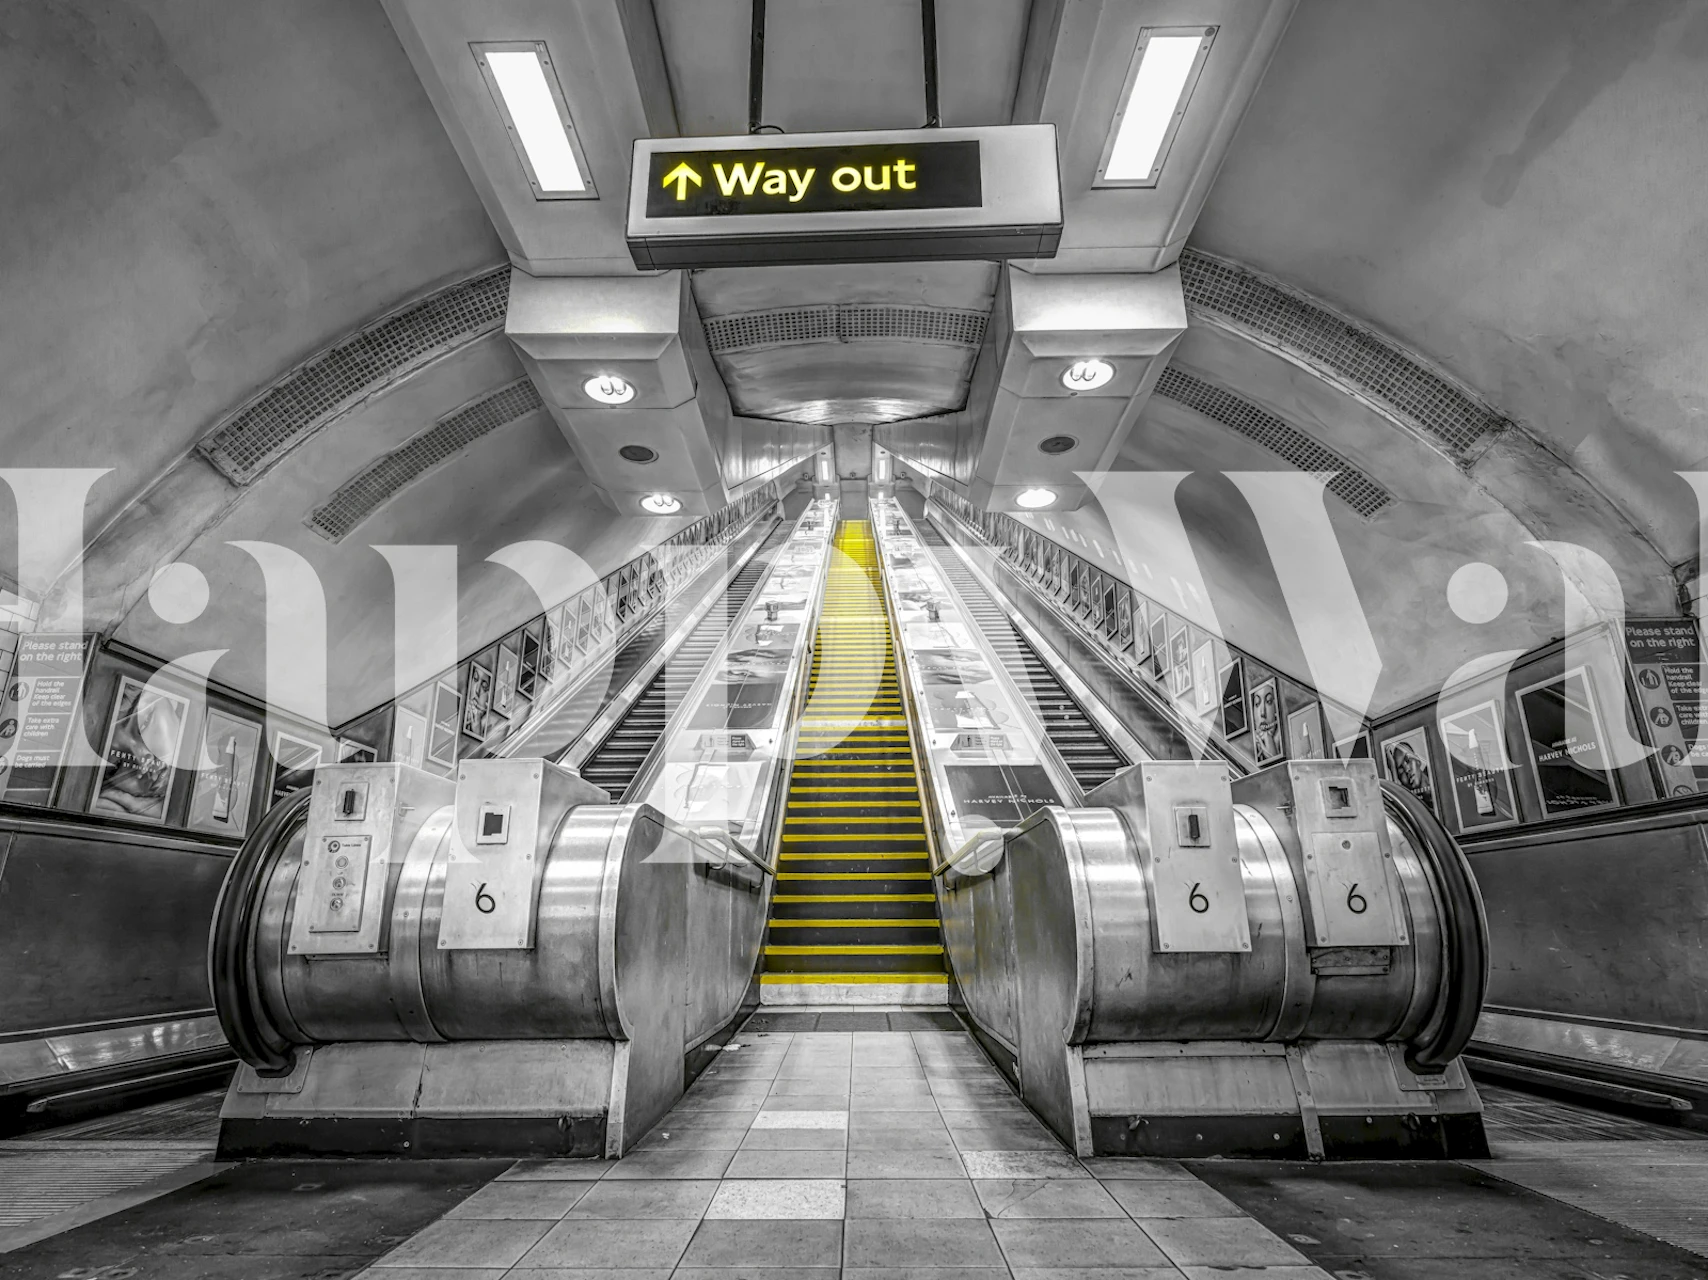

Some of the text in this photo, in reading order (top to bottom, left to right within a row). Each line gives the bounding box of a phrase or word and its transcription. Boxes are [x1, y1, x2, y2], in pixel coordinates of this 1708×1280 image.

[713, 159, 917, 202] Way out
[1625, 626, 1694, 636] Please stand
[22, 640, 89, 650] Please stand
[1629, 637, 1696, 649] on the right
[20, 652, 82, 663] on the right
[33, 694, 50, 702] Keep
[1539, 741, 1597, 762] HARVEY NICHOLS
[475, 882, 496, 914] 6
[1189, 882, 1209, 913] 6
[1347, 883, 1367, 914] 6
